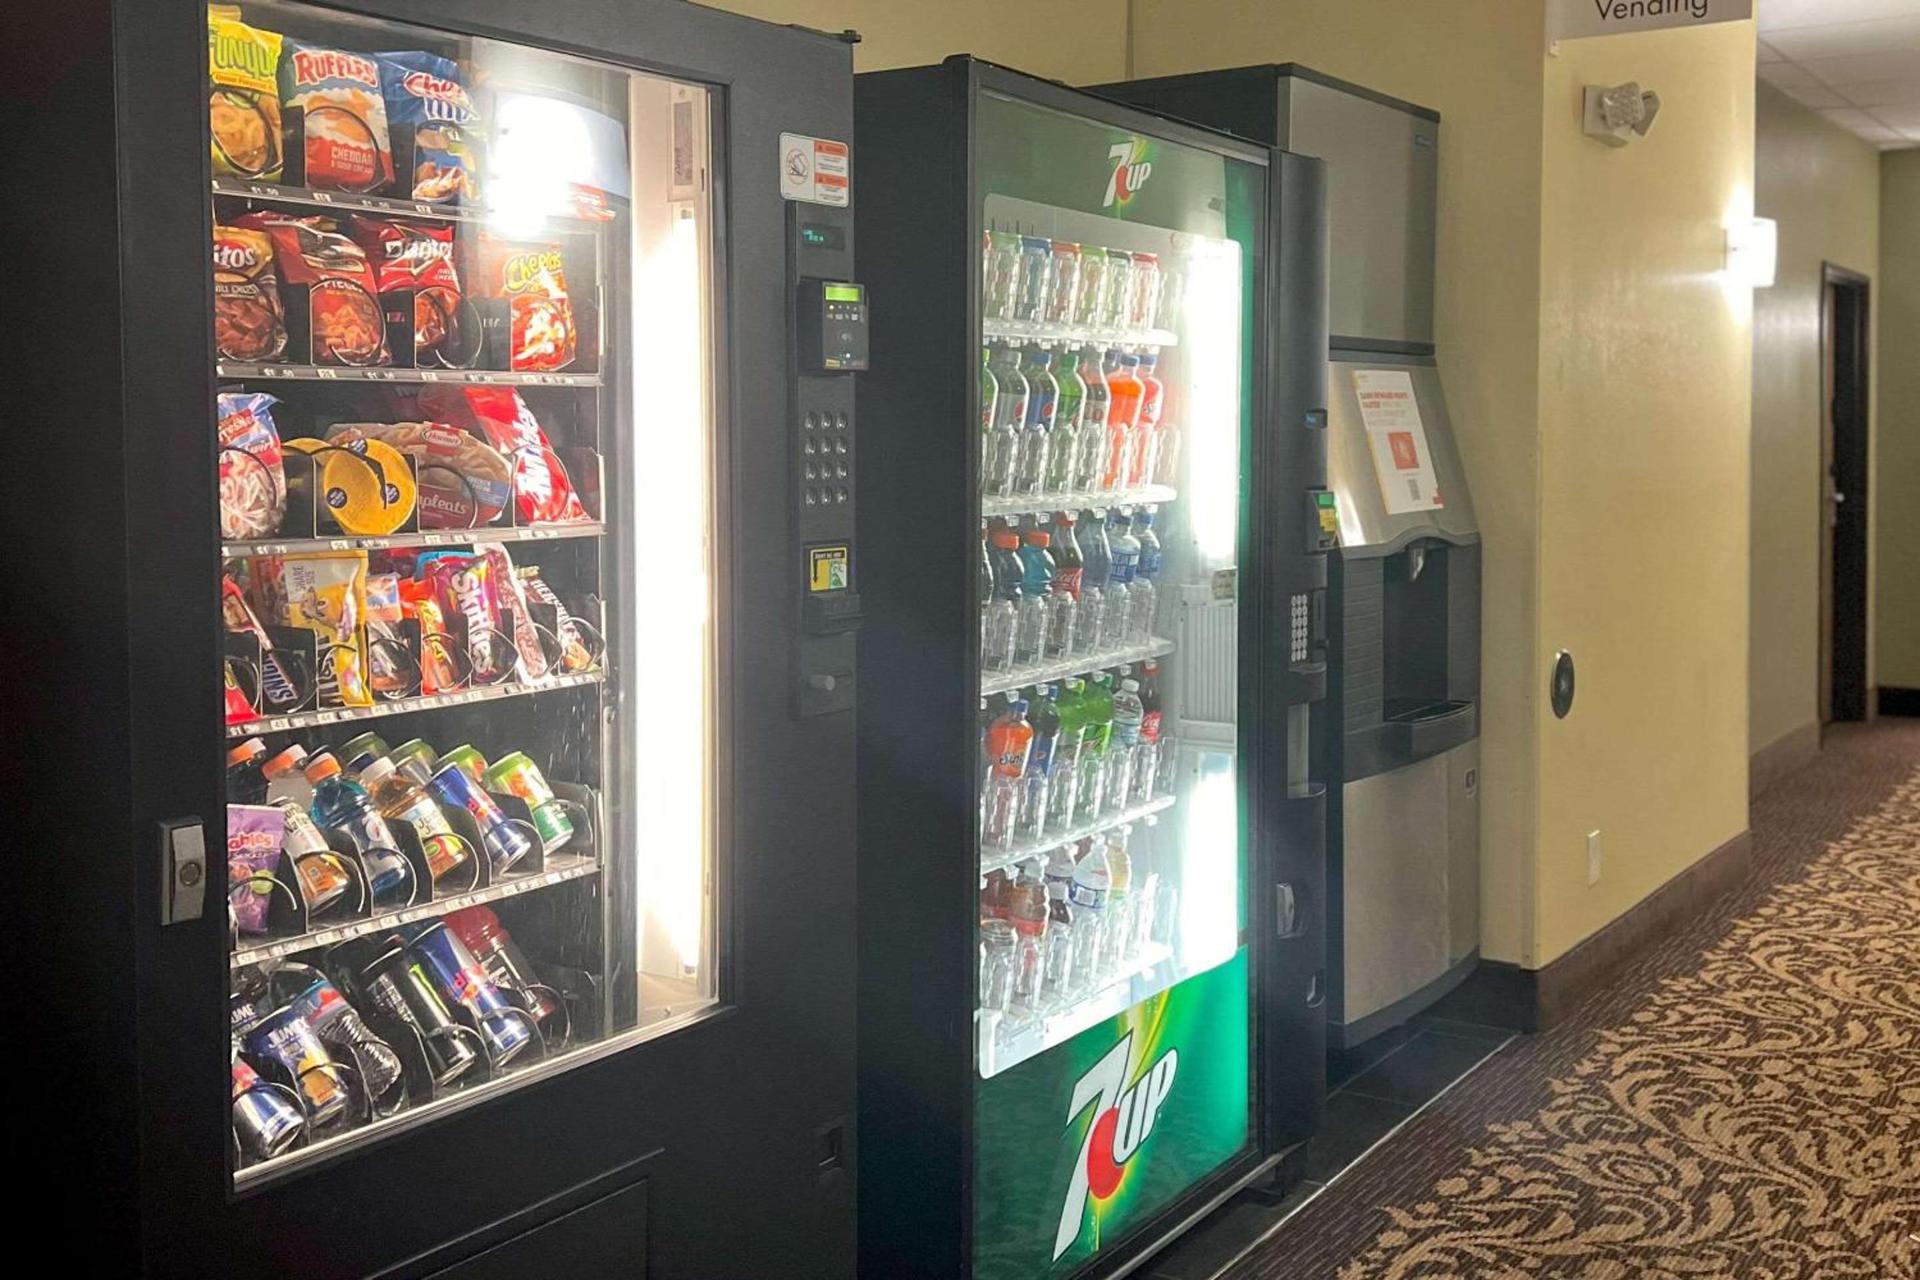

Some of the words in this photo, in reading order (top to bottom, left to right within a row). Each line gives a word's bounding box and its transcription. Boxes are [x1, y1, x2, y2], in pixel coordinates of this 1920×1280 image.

[1596, 0, 1708, 20] Vending
[292, 50, 378, 88] RUFFLES
[1103, 141, 1152, 207] 7UP
[1053, 1027, 1178, 1262] 7UP
